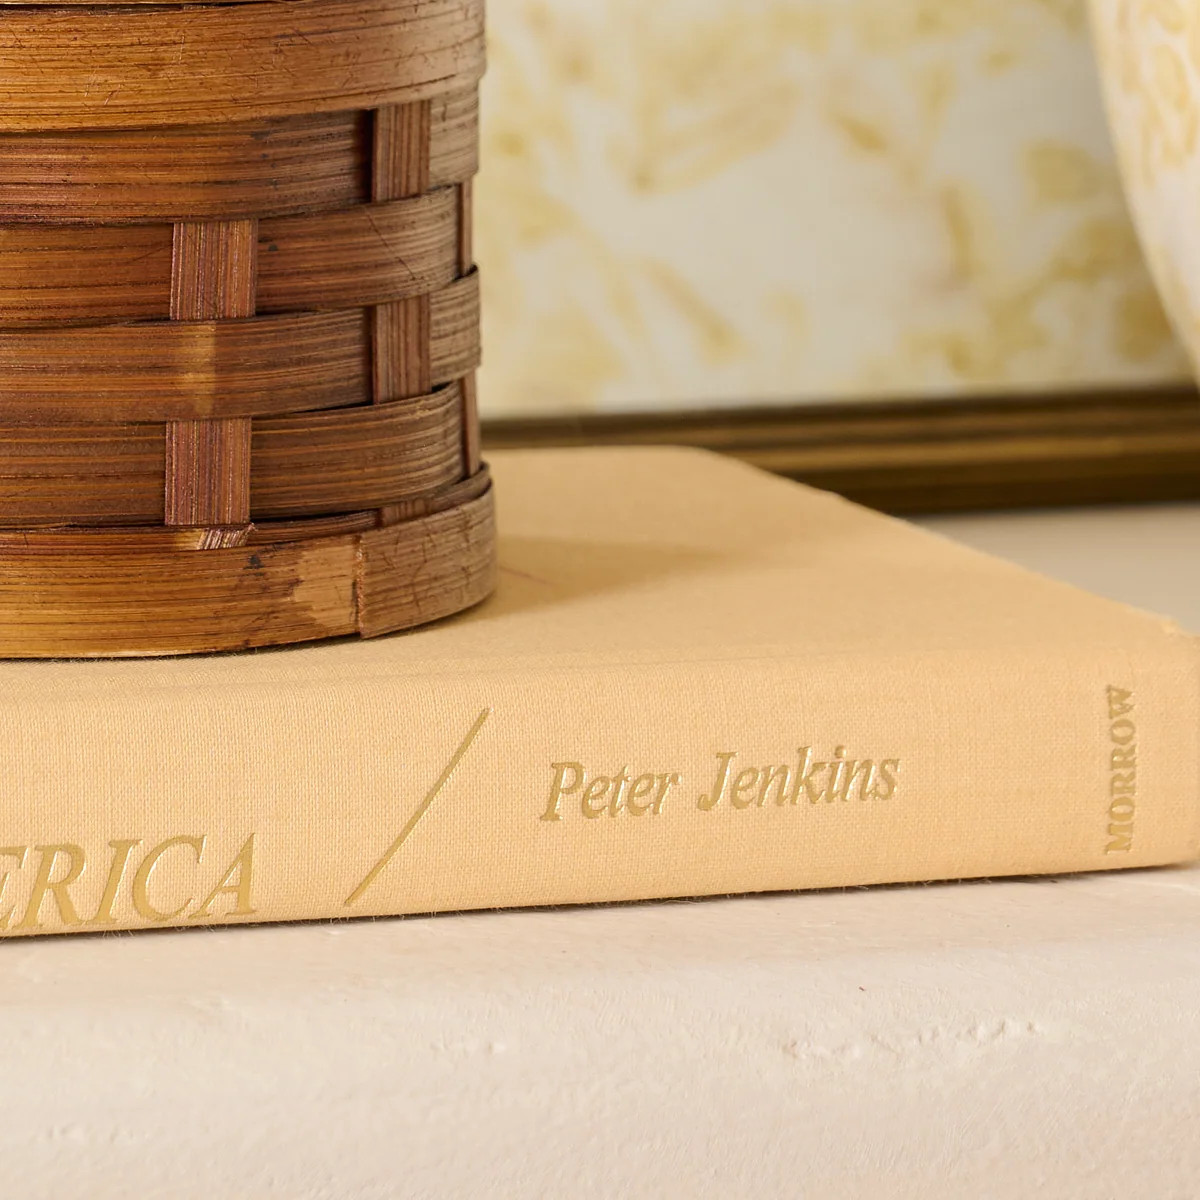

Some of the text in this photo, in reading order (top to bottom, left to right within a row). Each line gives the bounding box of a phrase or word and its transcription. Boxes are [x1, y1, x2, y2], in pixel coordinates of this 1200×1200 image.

[540, 745, 900, 822] Peter Jenkins
[1104, 684, 1138, 855] MORROW
